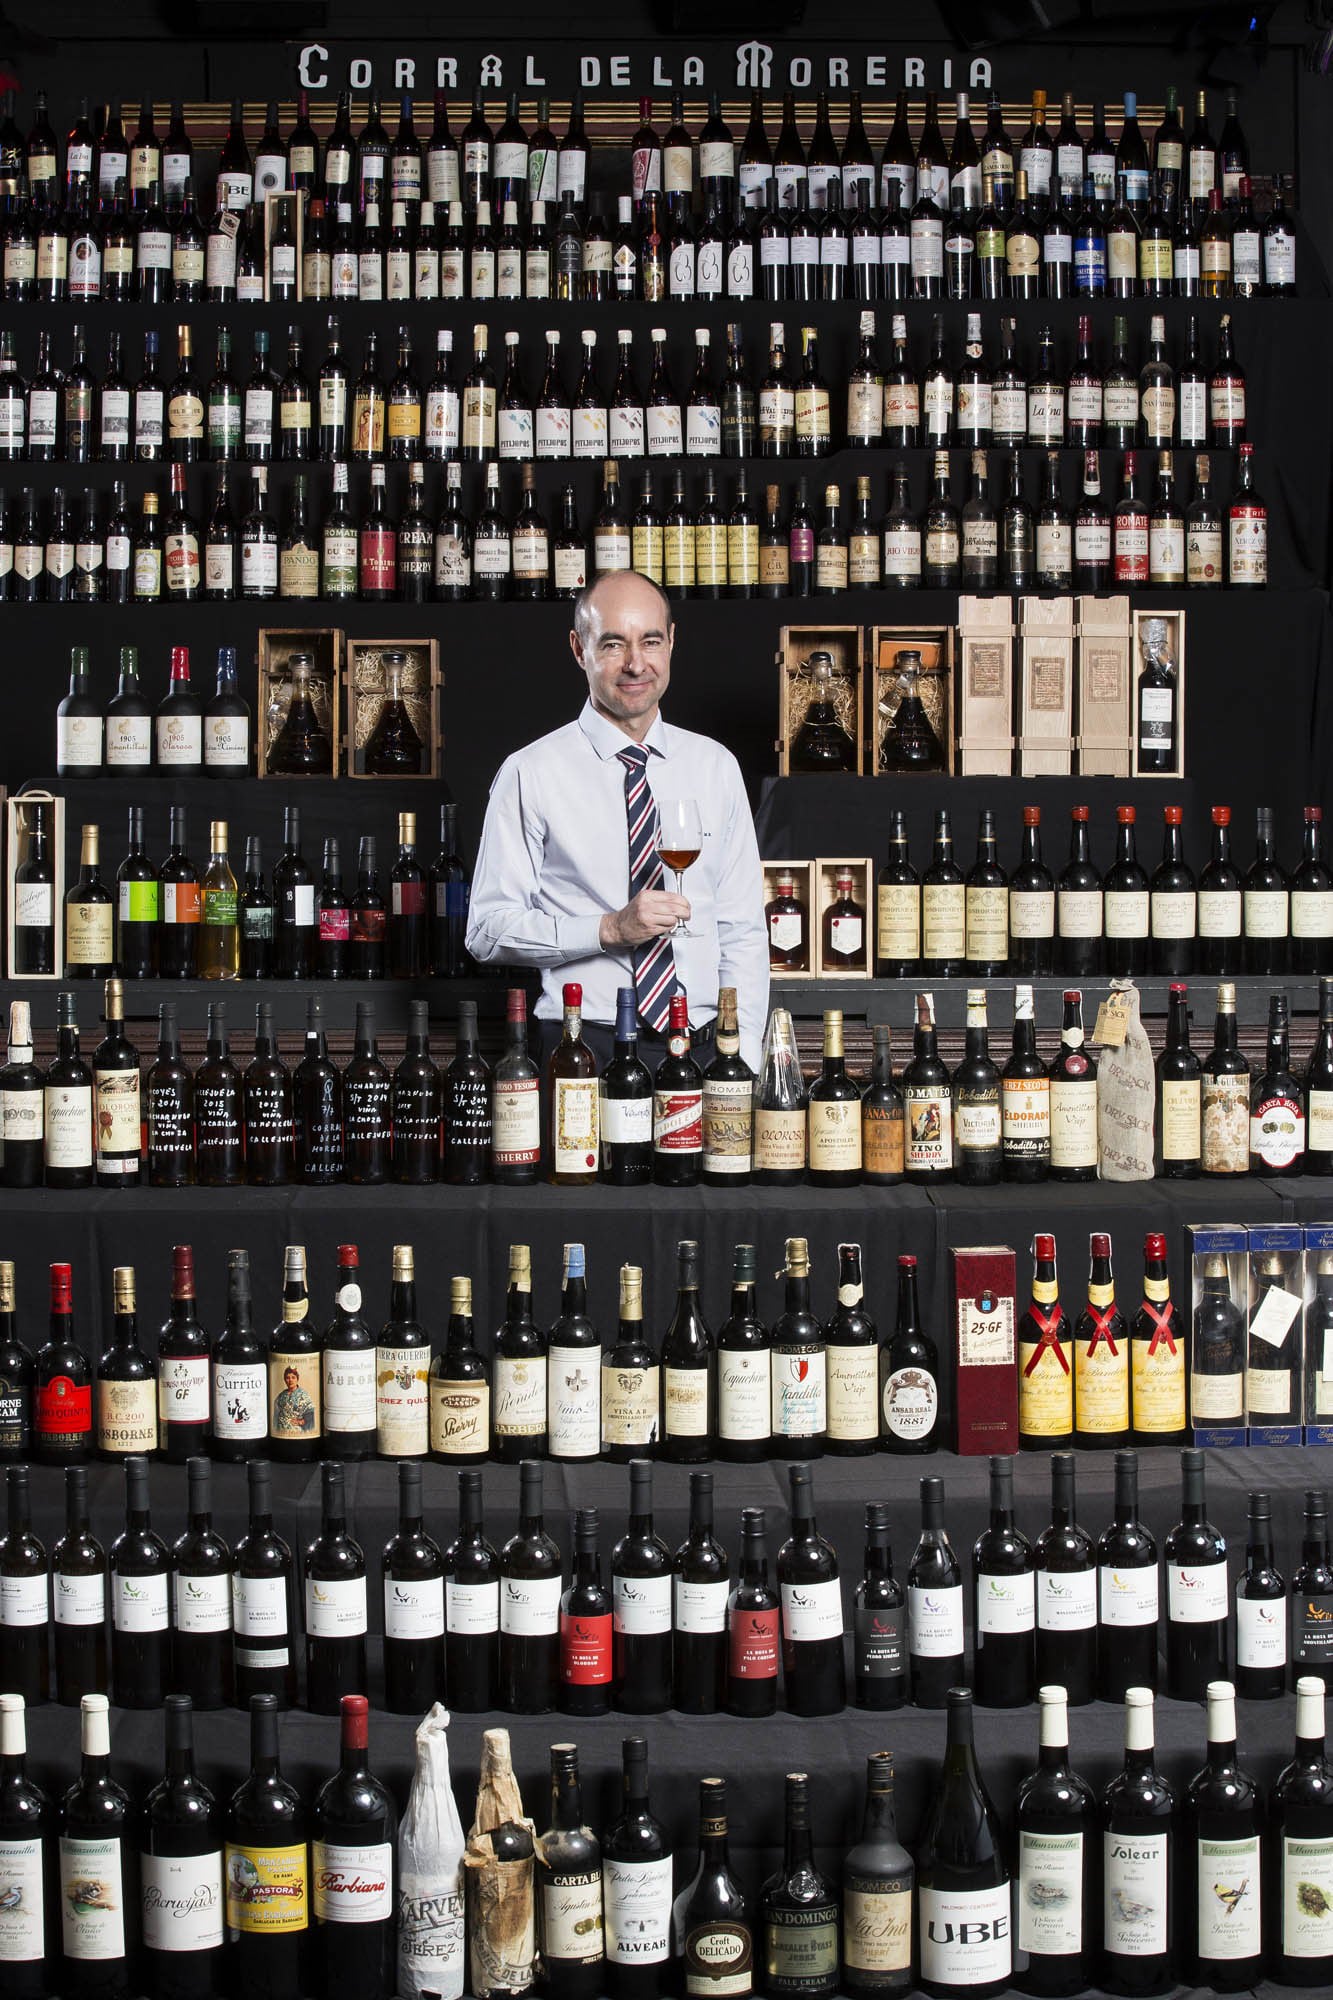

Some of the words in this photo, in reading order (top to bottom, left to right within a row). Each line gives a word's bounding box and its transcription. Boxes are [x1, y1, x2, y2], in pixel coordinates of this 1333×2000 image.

[298, 43, 546, 88] CORRAL
[580, 55, 631, 87] DE
[653, 56, 704, 86] LA
[736, 40, 992, 88] MORERIA
[1116, 516, 1149, 527] ROMATE
[399, 531, 433, 545] CREAM
[400, 561, 432, 573] SHERRY
[1119, 572, 1147, 580] SHERRY
[327, 583, 355, 591] SHERRY
[169, 734, 185, 742] 1905
[215, 735, 232, 743] 1905
[120, 886, 128, 897] 22
[1108, 1063, 1121, 1078] DRY
[453, 1081, 486, 1092] AÑINA
[513, 1081, 537, 1091] TESORO
[710, 1086, 752, 1094] ROMATE
[1023, 1080, 1041, 1090] SECO
[916, 1087, 950, 1098] MATEO
[958, 1088, 999, 1100] Bobadilla
[157, 1099, 181, 1109] 2014
[203, 1100, 225, 1108] 2015
[357, 1103, 377, 1113] VIÑA
[1258, 1099, 1282, 1115] CARTA
[1283, 1099, 1300, 1115] ROJA
[208, 1108, 229, 1118] VIÑA
[262, 1109, 282, 1119] VIÑA
[1104, 1103, 1125, 1122] DRY
[1126, 1114, 1151, 1134] SACK
[911, 1144, 942, 1152] FINO
[495, 1152, 535, 1163] SHERRY
[911, 1151, 942, 1160] SHERRY
[1103, 1146, 1122, 1162] DRY
[1126, 1156, 1149, 1173] SACK
[779, 1345, 818, 1353] DOMECQ
[215, 1376, 263, 1391] Currito
[175, 1388, 190, 1400] GF
[891, 1407, 914, 1415] ANSAR
[915, 1406, 932, 1414] REAL
[899, 1417, 924, 1426] 1887
[441, 1417, 478, 1440] Sherry
[100, 1428, 154, 1441] OSBORNE
[1110, 1846, 1160, 1860] Solear
[315, 1871, 386, 1893] Barbiana
[553, 1875, 589, 1886] CARTA
[252, 1887, 294, 1895] PASTORA
[853, 1881, 901, 1892] DOMECQ
[769, 1912, 783, 1923] AN
[785, 1908, 838, 1924] DOMINGO
[927, 1915, 1009, 1944] UBE
[616, 1939, 667, 1953] ALVEAR
[710, 1936, 730, 1945] Croft
[700, 1944, 741, 1957] DELICADO
[502, 1970, 517, 1981] DE
[800, 1977, 827, 1985] CREAM
